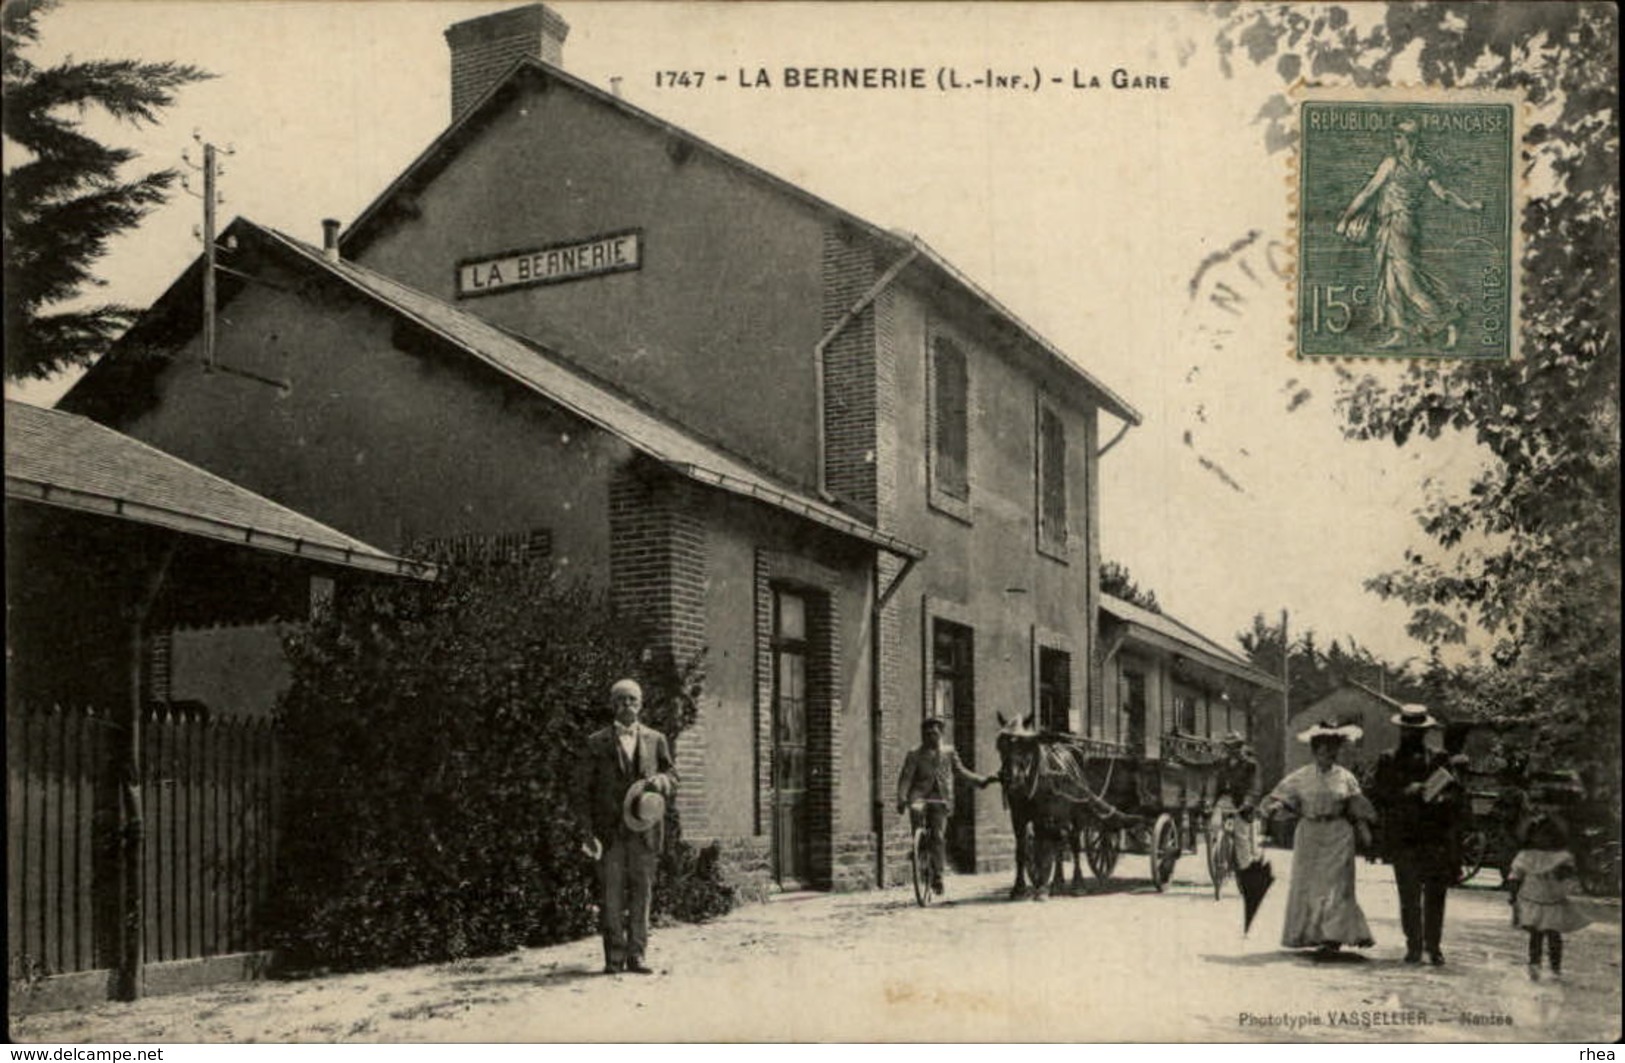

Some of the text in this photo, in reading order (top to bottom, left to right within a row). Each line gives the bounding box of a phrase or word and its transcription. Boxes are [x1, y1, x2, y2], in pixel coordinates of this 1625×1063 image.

[473, 240, 626, 288] LA BERNERIE
[1481, 266, 1501, 347] POSTES
